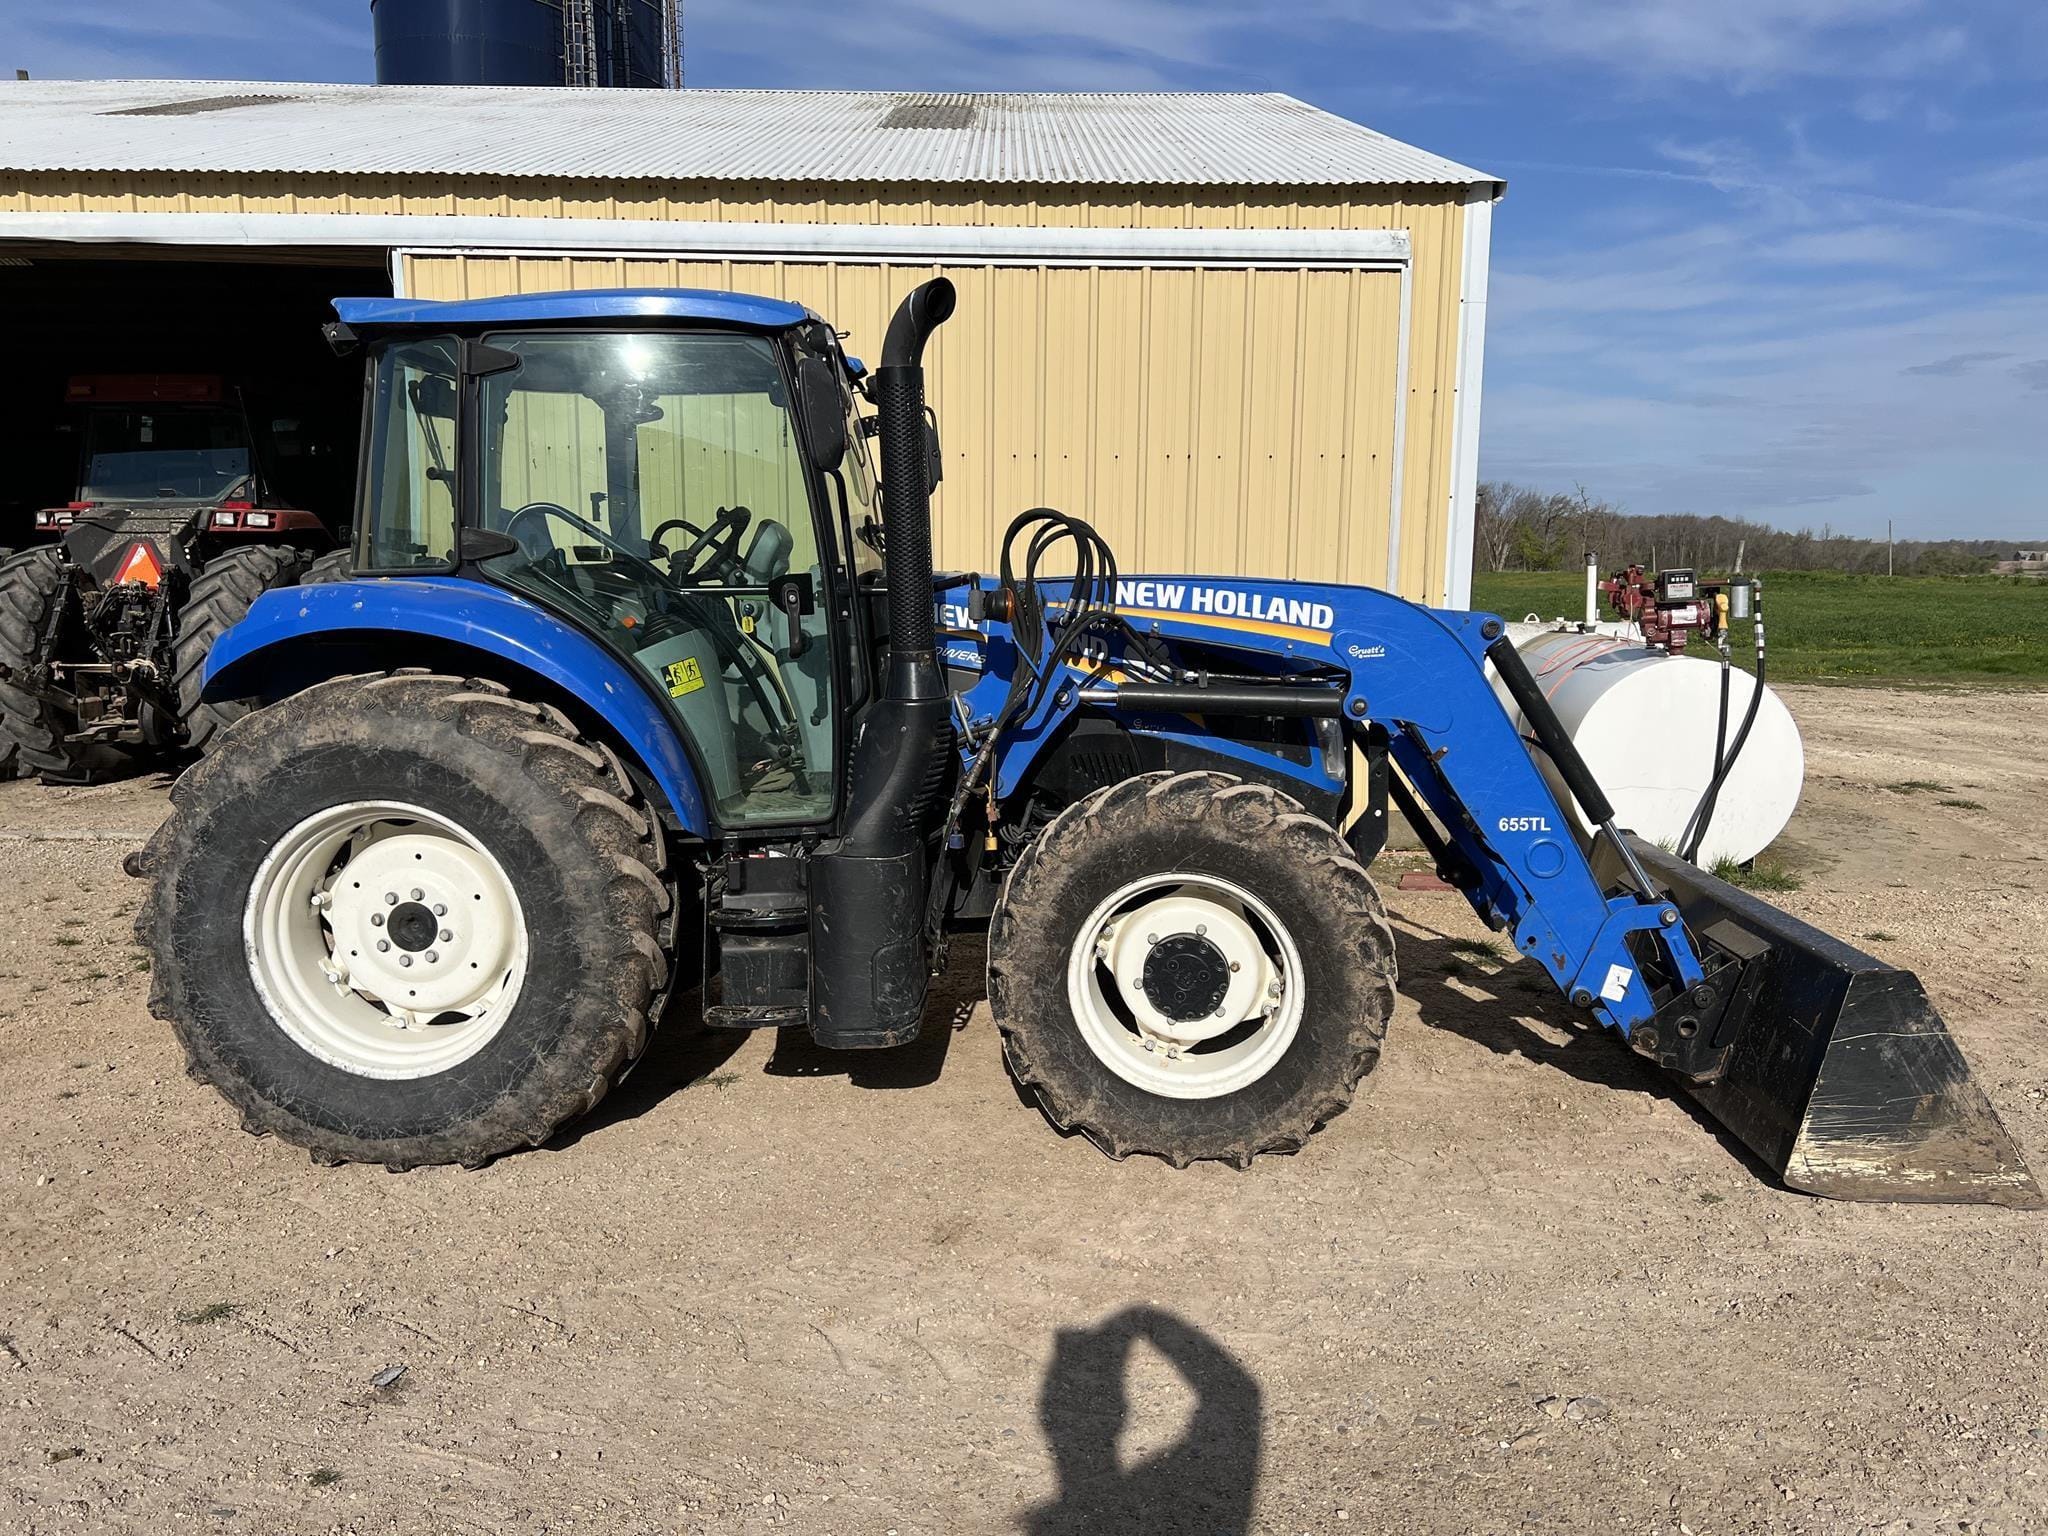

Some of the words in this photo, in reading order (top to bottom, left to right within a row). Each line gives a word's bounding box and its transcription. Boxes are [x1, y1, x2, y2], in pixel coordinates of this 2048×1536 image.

[1116, 581, 1185, 609] NEW
[1191, 587, 1334, 629] HOLLAND
[1498, 817, 1551, 832] 655TL
